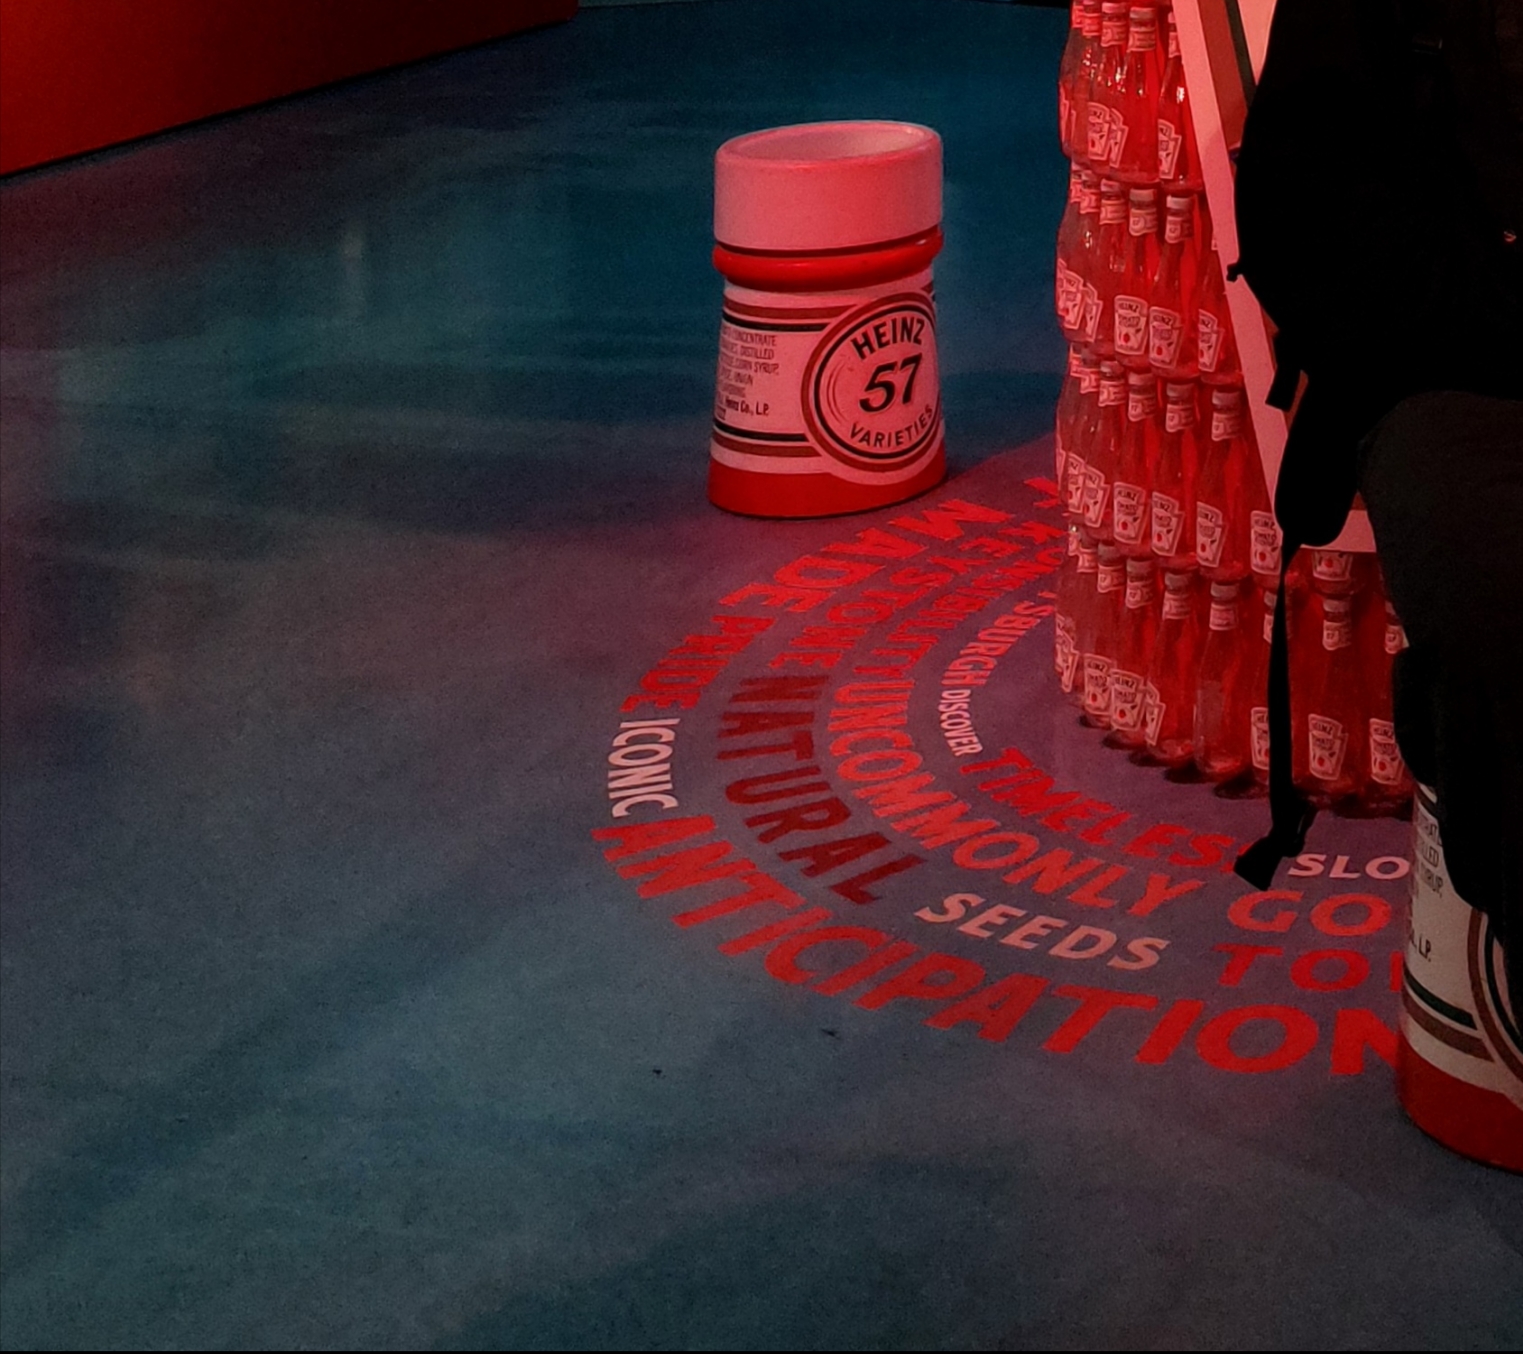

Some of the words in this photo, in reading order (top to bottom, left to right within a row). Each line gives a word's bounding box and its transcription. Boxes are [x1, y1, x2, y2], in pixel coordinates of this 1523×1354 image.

[851, 316, 926, 360] HEINZ
[858, 352, 924, 414] 57
[849, 402, 935, 449] VARIETIES
[719, 499, 1016, 613] MADE
[619, 614, 774, 714] PRIDE
[940, 592, 1056, 687] SBURGH
[607, 717, 681, 818] ICONIC
[937, 688, 984, 758] DISCOVER
[716, 675, 929, 905] NATURAL
[827, 679, 1207, 919] UNCOMMONLY
[960, 748, 1254, 874] TIMELES
[1287, 853, 1410, 880] SLO
[914, 892, 1171, 970] SEEDS
